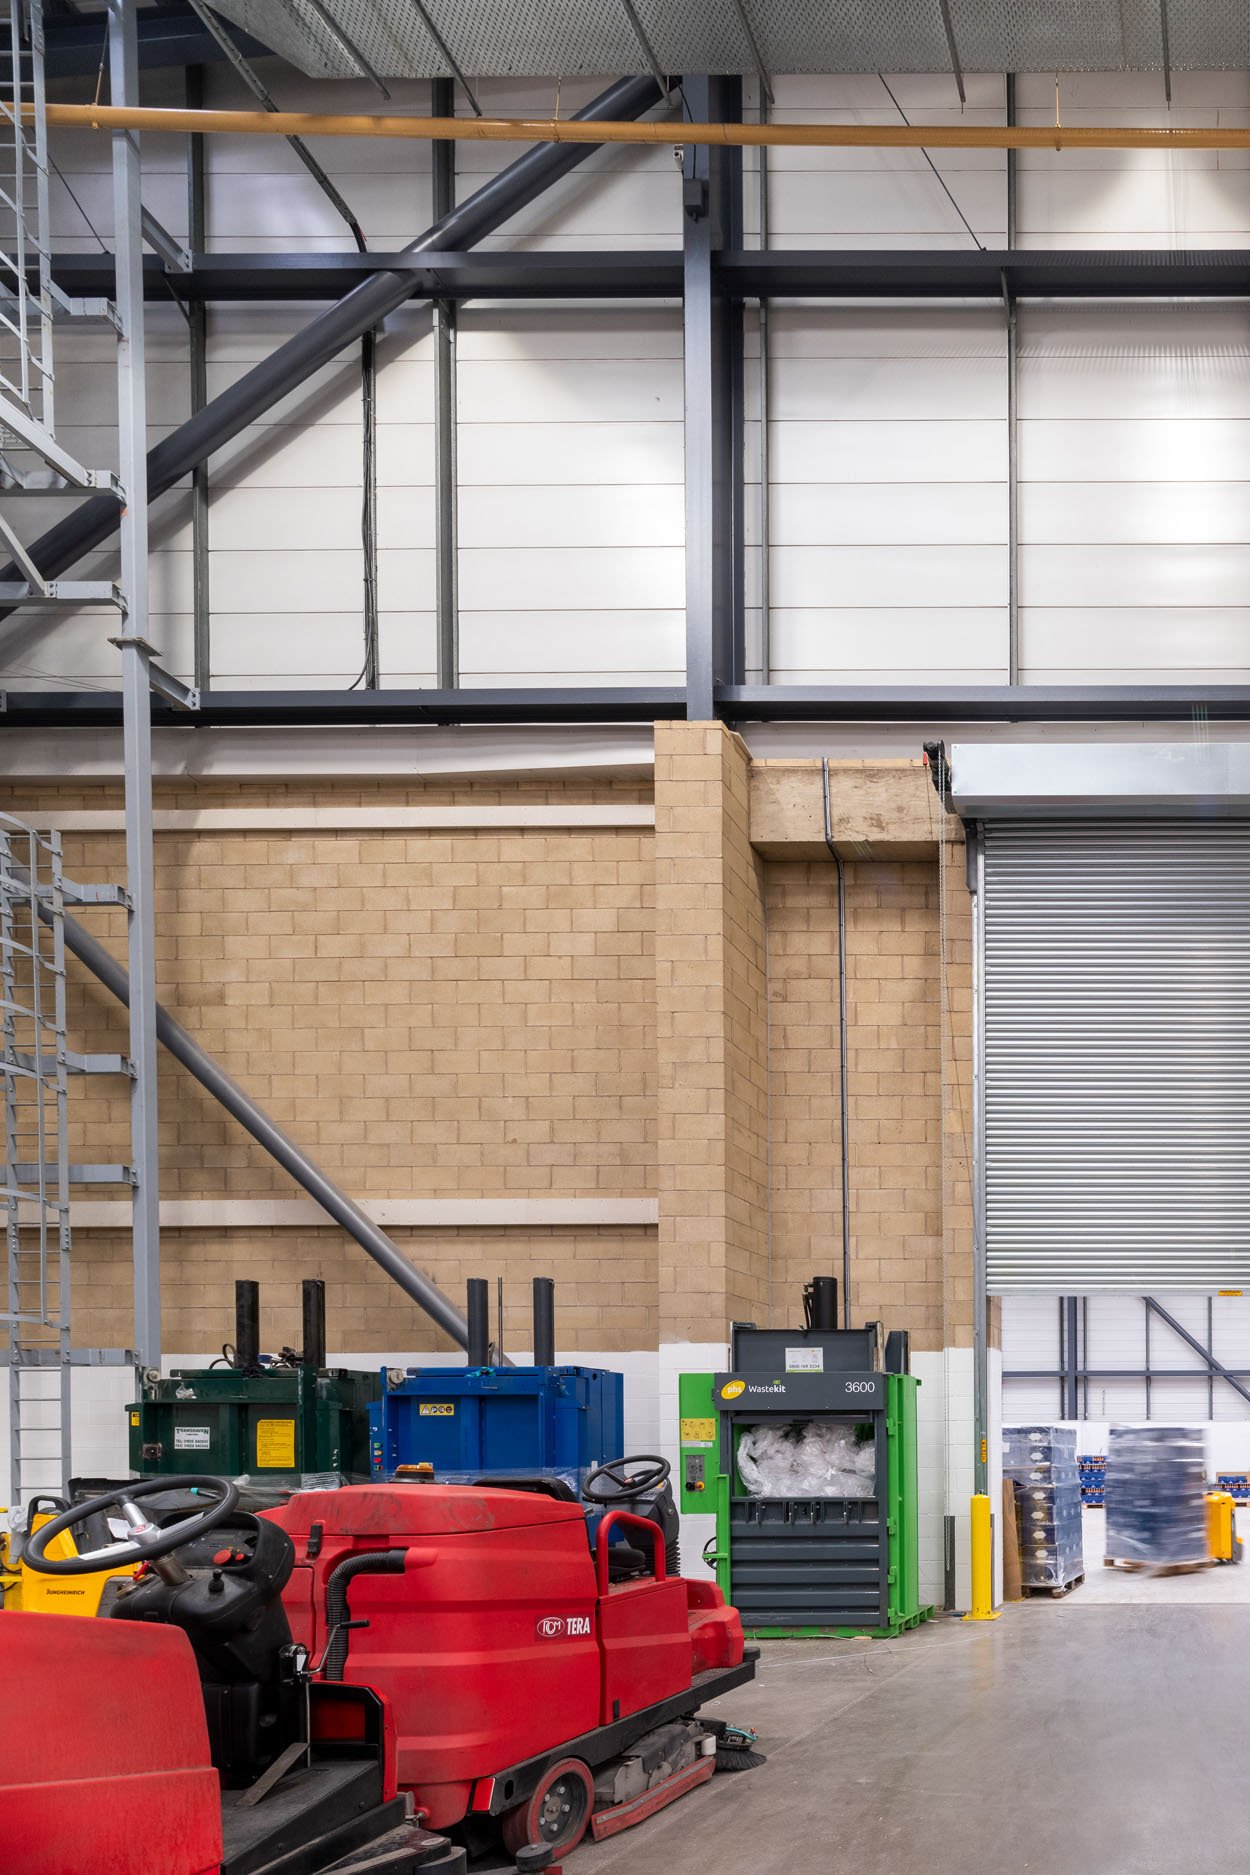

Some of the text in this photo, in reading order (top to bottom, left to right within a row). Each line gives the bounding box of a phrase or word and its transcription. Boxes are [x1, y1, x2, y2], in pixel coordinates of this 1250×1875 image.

[727, 1384, 786, 1394] phs Wastekit
[845, 1382, 875, 1393] 3600
[566, 1617, 591, 1635] TERA
